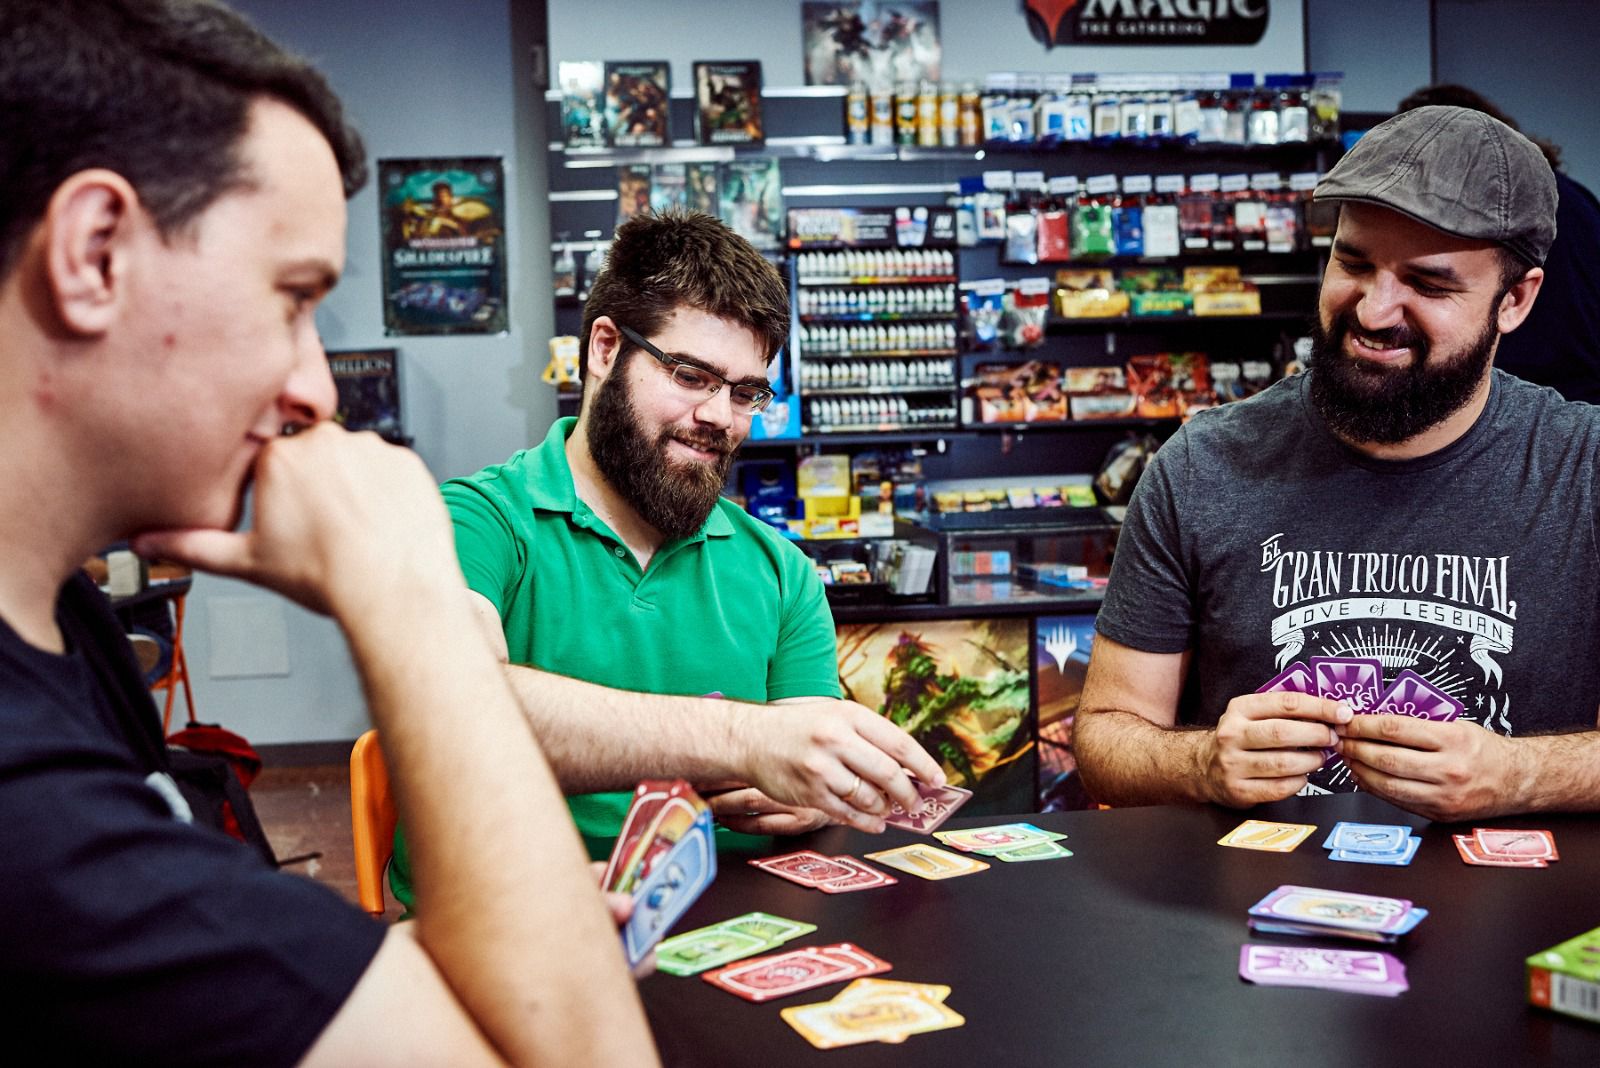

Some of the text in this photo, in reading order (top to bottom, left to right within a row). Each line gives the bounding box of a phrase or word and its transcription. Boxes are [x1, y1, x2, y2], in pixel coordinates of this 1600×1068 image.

[1080, 22, 1206, 35] THE GATHERING
[1260, 538, 1282, 568] EL
[1272, 551, 1517, 621] GRAN TRUCO FINAL
[1288, 601, 1503, 641] LOVE of LESBIAN
